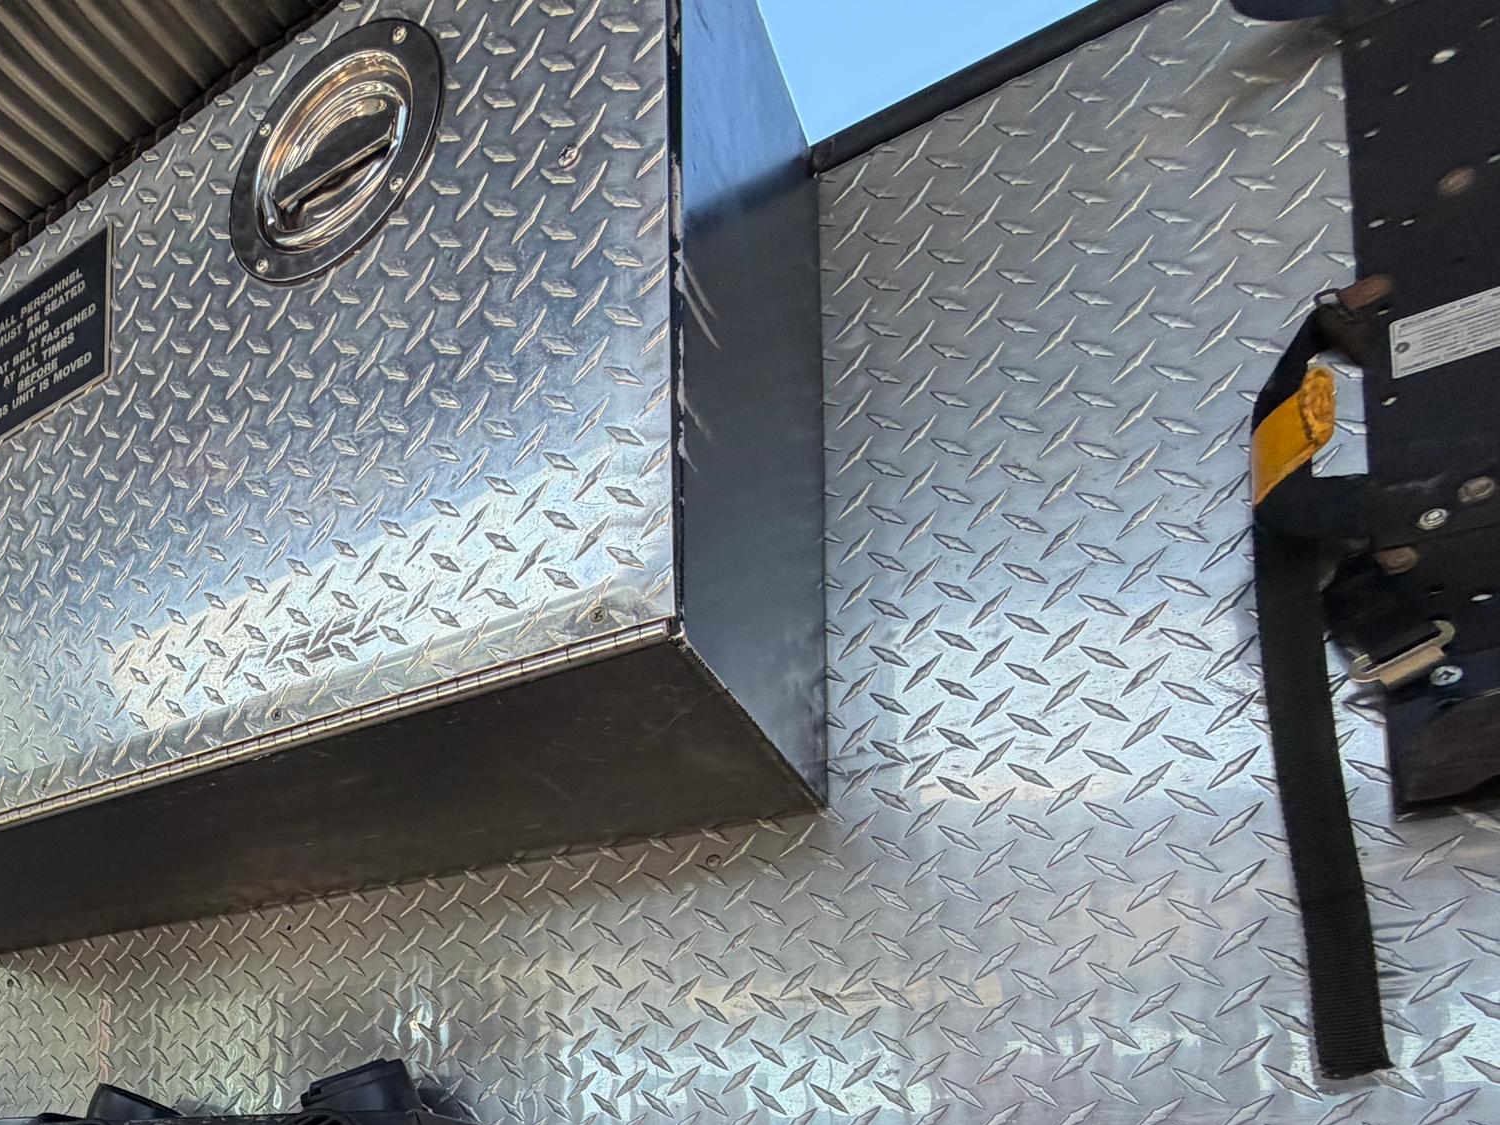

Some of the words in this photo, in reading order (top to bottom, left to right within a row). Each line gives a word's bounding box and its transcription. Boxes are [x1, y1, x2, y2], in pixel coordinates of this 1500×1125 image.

[20, 268, 83, 315] PERSONNEL
[26, 312, 41, 327] BE
[44, 280, 86, 316] SEATED
[12, 343, 38, 367] BELT
[41, 303, 97, 347] FASTENED
[27, 320, 49, 342] AND
[3, 372, 17, 388] AT
[19, 357, 38, 377] ALL
[42, 332, 75, 361] TIMES
[12, 386, 36, 410] UNIT
[39, 378, 50, 393] IS
[53, 351, 93, 384] MOVED
[17, 357, 59, 393] BEFORE
